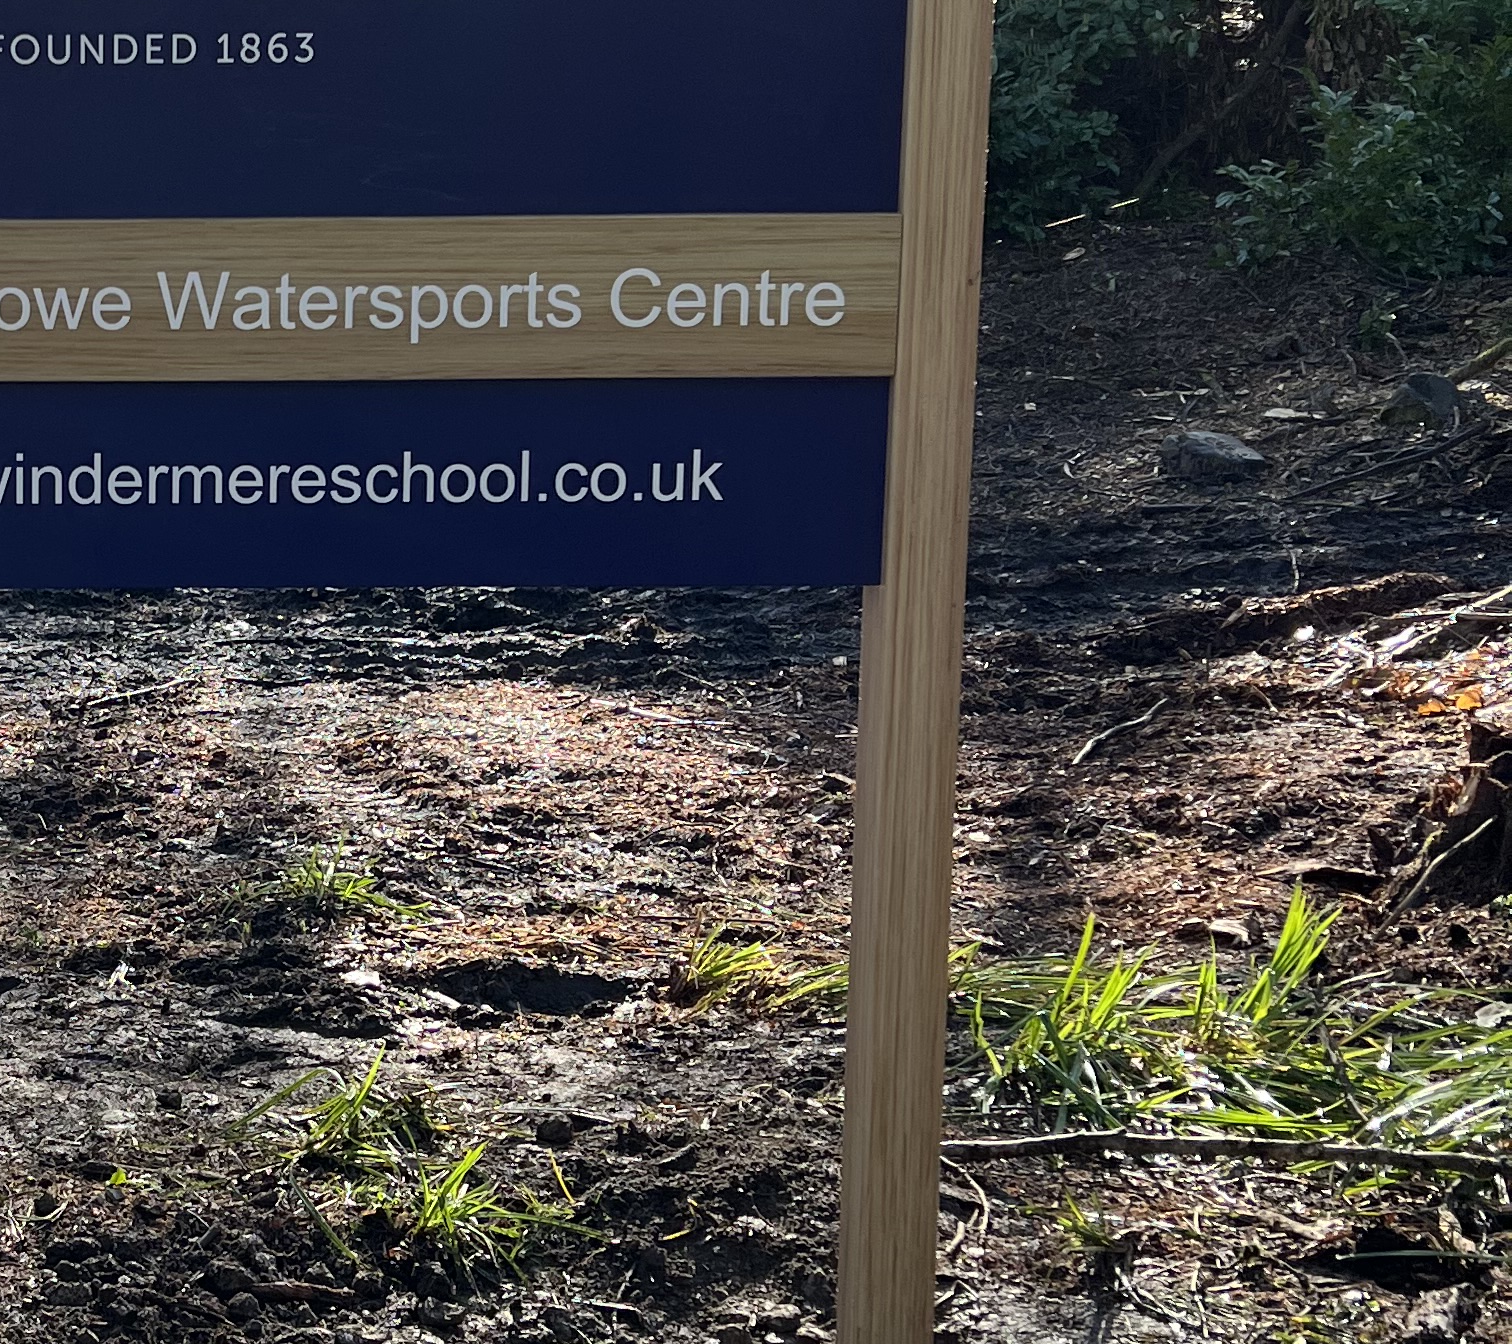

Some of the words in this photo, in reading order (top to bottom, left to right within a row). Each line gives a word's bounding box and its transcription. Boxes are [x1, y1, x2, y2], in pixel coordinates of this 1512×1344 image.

[217, 33, 313, 63] 1863
[157, 272, 581, 343] Watersports
[611, 268, 844, 327] Centre
